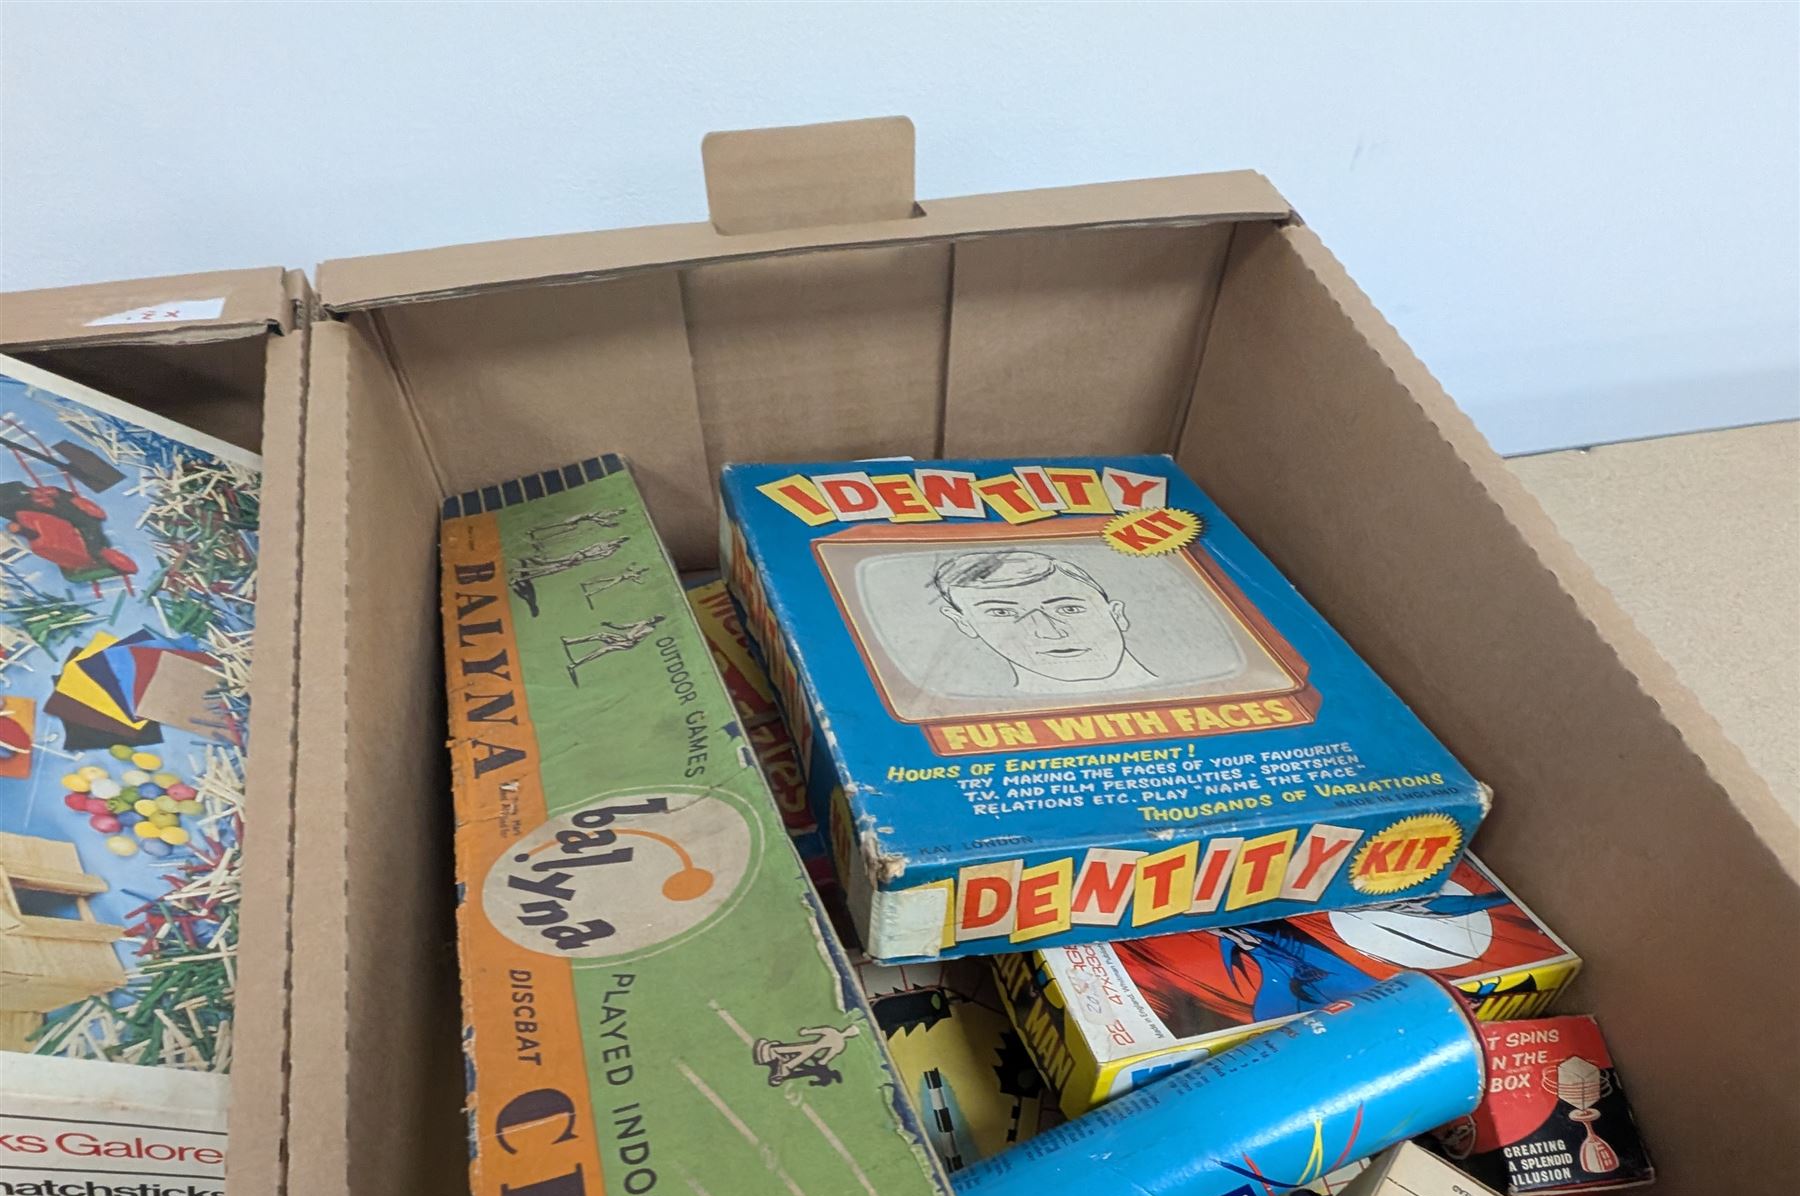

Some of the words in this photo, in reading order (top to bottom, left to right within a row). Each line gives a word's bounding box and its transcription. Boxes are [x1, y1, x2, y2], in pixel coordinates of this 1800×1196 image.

[779, 471, 1161, 516] IDENTITY
[1116, 509, 1190, 551] KIT
[454, 561, 528, 780] BALYNA
[655, 636, 699, 706] OUTDOOR
[684, 711, 706, 779] GAMES
[941, 720, 1034, 751] FUN
[1043, 709, 1169, 742] WITH
[1169, 699, 1295, 733] FACES
[887, 764, 960, 782] HOURS
[970, 763, 996, 776] OF
[957, 778, 993, 790] TRY
[1002, 772, 1076, 787] MAKING
[1080, 768, 1114, 780] THE
[1121, 762, 1177, 776] FACES
[1182, 759, 1203, 772] OF
[1209, 754, 1256, 767] YOUR
[1260, 742, 1353, 762] FAVOURITE
[963, 790, 1000, 802] T.V.
[1007, 786, 1045, 799] AND
[1050, 782, 1095, 795] FILM
[1103, 769, 1243, 791] PERSONALITIES
[1260, 754, 1360, 775] SPORTSMEN
[973, 796, 1084, 816] RELATIONS
[1142, 788, 1188, 802] PLAY
[1268, 773, 1302, 787] THE
[1137, 795, 1272, 821] THOUSANDS
[1283, 790, 1307, 803] OF
[1315, 772, 1445, 799] VARIATIONS
[1360, 835, 1453, 876] KIT
[961, 834, 1355, 931] DENTITY
[508, 969, 542, 1066] DISCBAT
[600, 973, 636, 1087] PLAYED
[1505, 1028, 1560, 1047] SPINS
[1511, 1050, 1549, 1067] THE
[1489, 1073, 1532, 1093] BOX
[55, 1132, 224, 1165] Galore
[1503, 1139, 1567, 1158] CREATING
[1508, 1161, 1518, 1172] A
[1520, 1152, 1574, 1171] SPLENDID
[1511, 1167, 1572, 1186] ILLUSION
